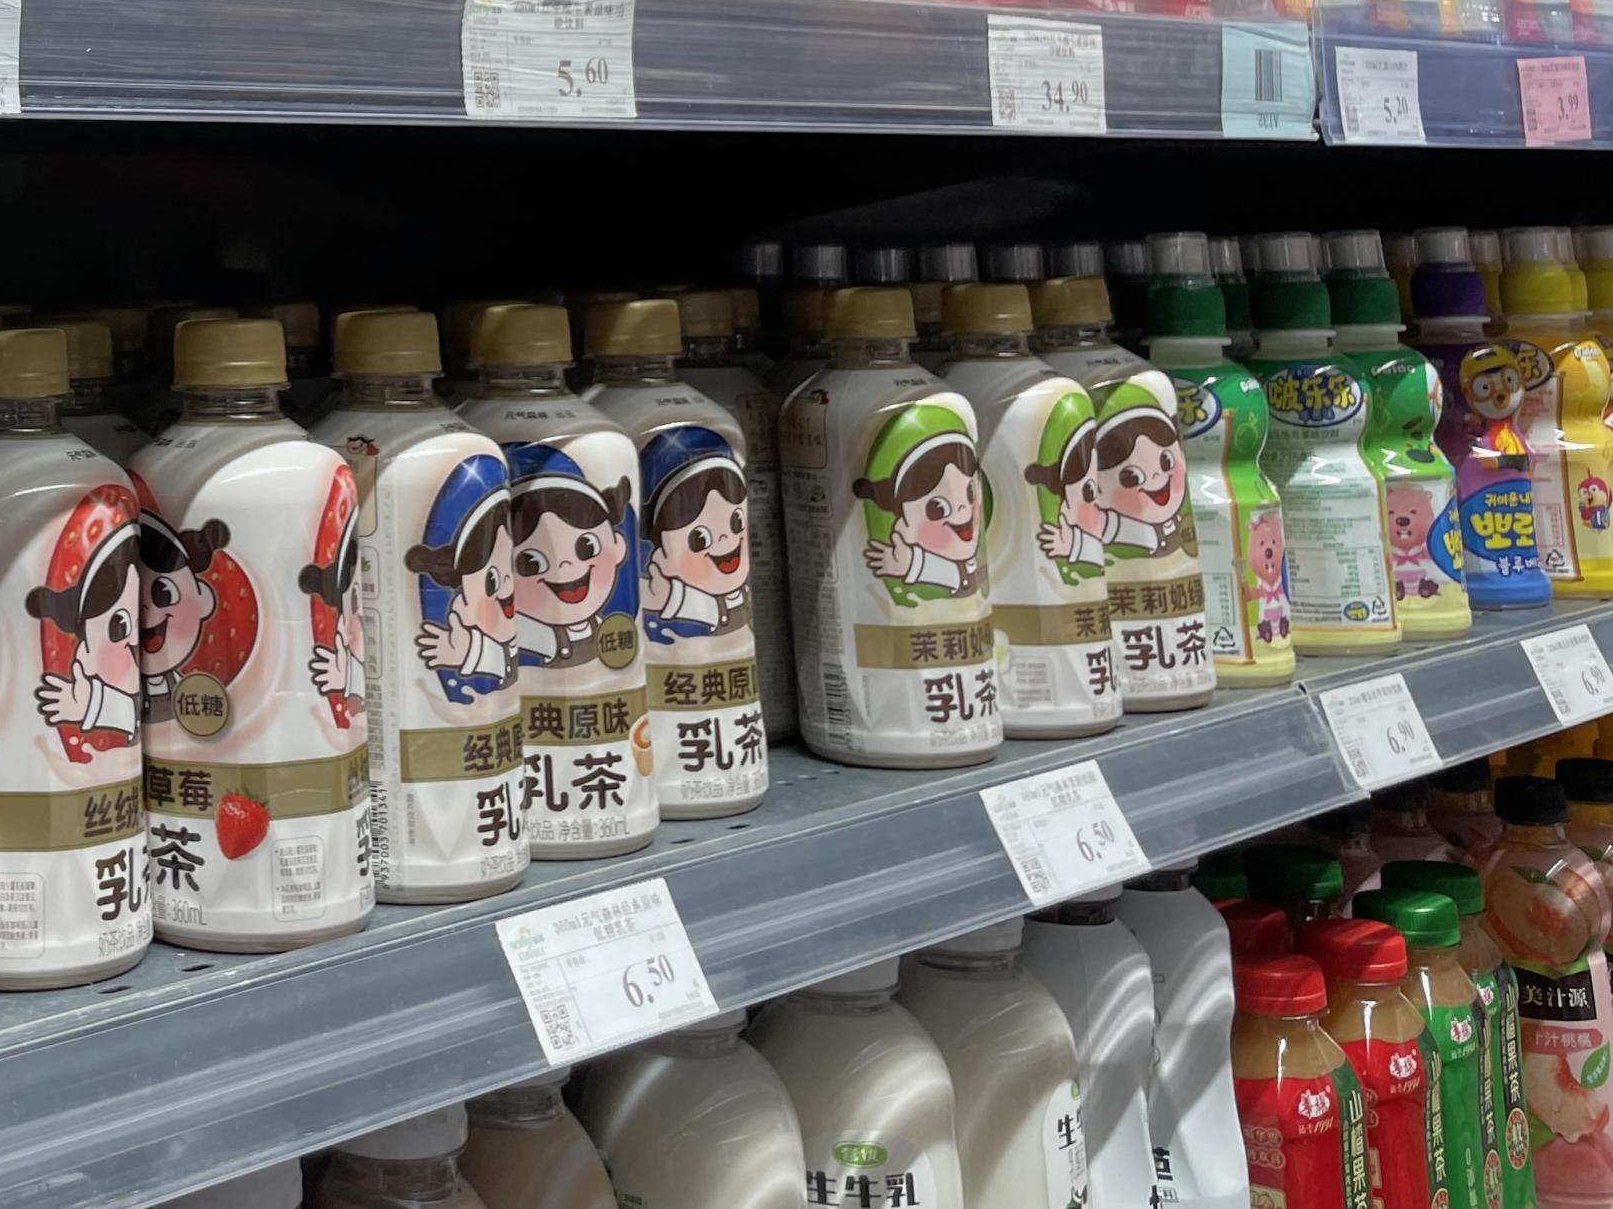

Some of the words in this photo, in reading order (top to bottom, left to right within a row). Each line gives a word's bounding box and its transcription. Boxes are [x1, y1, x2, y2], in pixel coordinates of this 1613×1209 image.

[557, 57, 609, 98] 5.60
[1041, 79, 1088, 113] 34.90
[1383, 96, 1409, 124] 5.20
[1557, 92, 1580, 122] 3.99
[1268, 374, 1361, 412] 啵乐乐
[598, 629, 635, 653] 低糖
[1120, 618, 1207, 671] 乳茶
[923, 668, 998, 724] 乳茶
[1581, 666, 1607, 696] 6.90
[177, 692, 224, 718] 低糖
[676, 710, 763, 773] 乳茶
[1386, 720, 1415, 755] 6.90
[521, 750, 627, 813] 乳茶
[476, 780, 519, 848] 乳
[150, 824, 205, 892] 茶
[1076, 820, 1115, 862] 6.50
[622, 953, 676, 1008] 6.50
[1522, 985, 1590, 1009] 美汁源
[806, 1170, 920, 1208] 生牛乳
